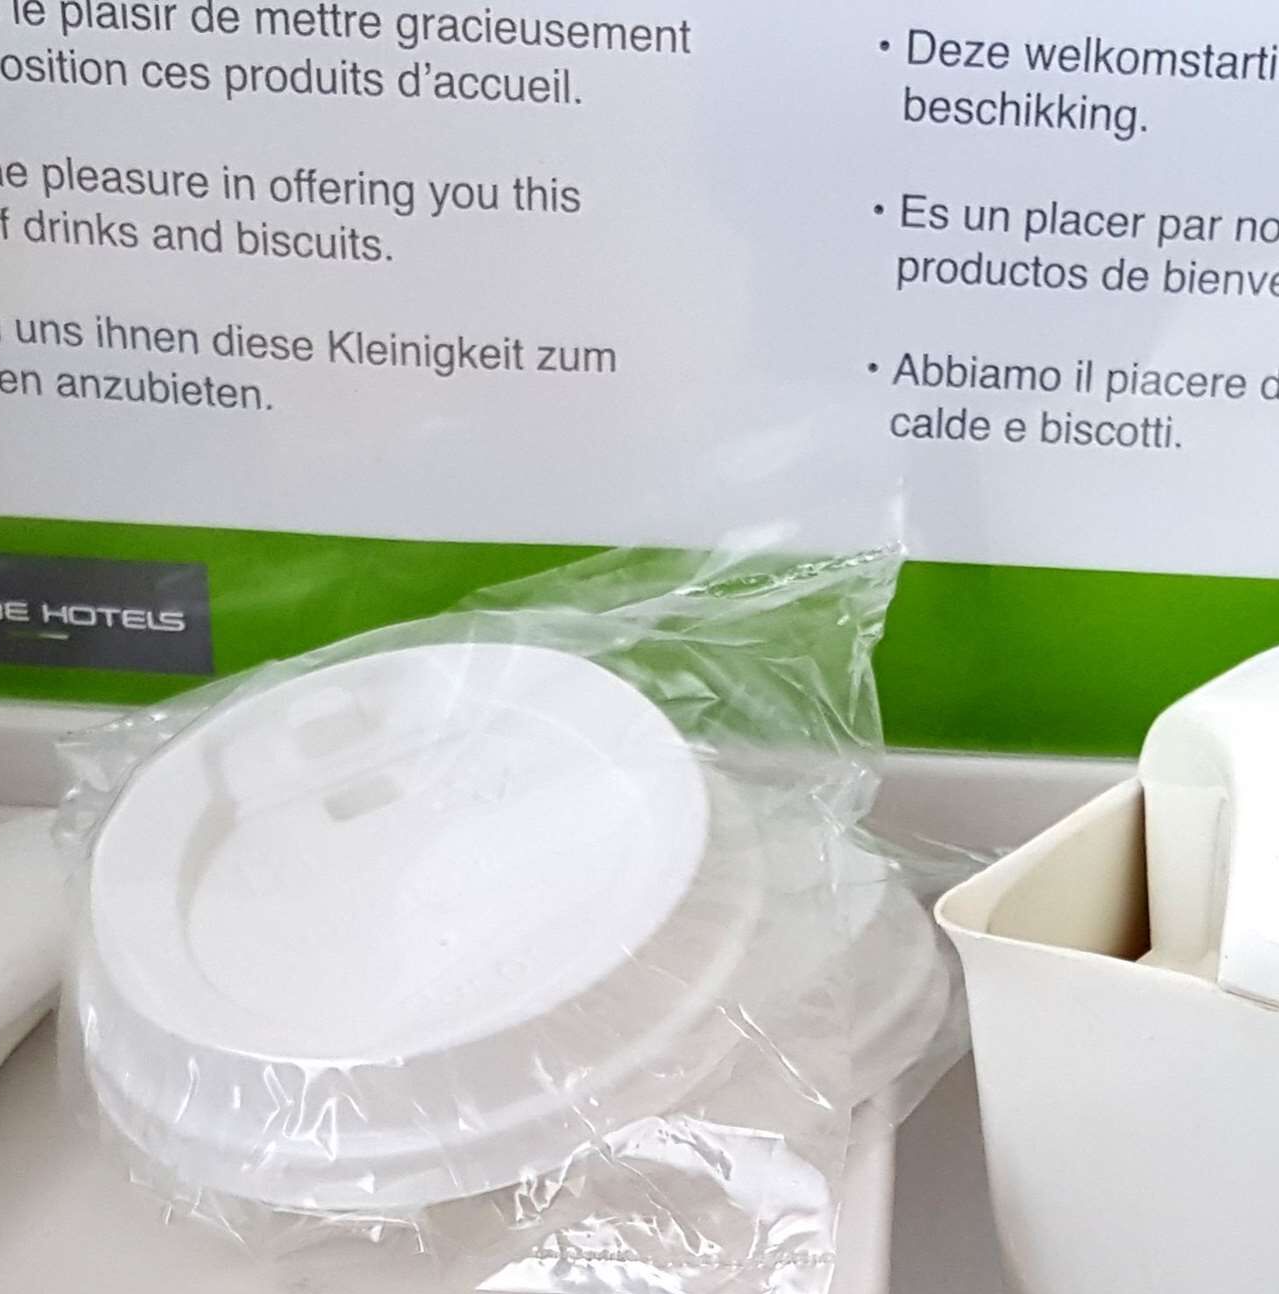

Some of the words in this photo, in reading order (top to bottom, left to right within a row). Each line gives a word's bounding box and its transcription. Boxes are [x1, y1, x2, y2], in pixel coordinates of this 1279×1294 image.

[12, 0, 46, 27] le
[59, 0, 178, 38] plaisir
[190, 0, 241, 35] de
[254, 2, 382, 40] mettre
[395, 7, 692, 55] gracieusement
[907, 27, 1011, 71] Deze
[141, 60, 212, 91] ces
[224, 57, 385, 101] produits
[903, 85, 1148, 142] beschikking.
[41, 155, 210, 199] pleasure
[222, 164, 256, 201] in
[269, 167, 415, 217] offering
[428, 181, 499, 218] you
[512, 175, 581, 214] this
[23, 208, 139, 249] drinks
[152, 218, 223, 254] and
[236, 220, 393, 262] biscuits.
[900, 192, 950, 231] Es
[963, 204, 1011, 233] un
[1023, 200, 1147, 244] placer
[1157, 213, 1224, 249] par
[896, 250, 1089, 292] productos
[1101, 256, 1150, 293] de
[15, 318, 84, 348] uns
[95, 314, 200, 355] ihnen
[212, 323, 314, 362] diese
[327, 329, 525, 378] Kleinigkeit
[536, 345, 617, 373] zum
[56, 369, 273, 411] anzubieten.
[891, 352, 1062, 393] Abbiamo
[1075, 359, 1093, 393] il
[1105, 361, 1248, 403] piacere
[889, 406, 992, 442] calde
[1003, 417, 1027, 443] e
[1039, 410, 1182, 449] biscotti.
[41, 600, 187, 632] HOTELS
